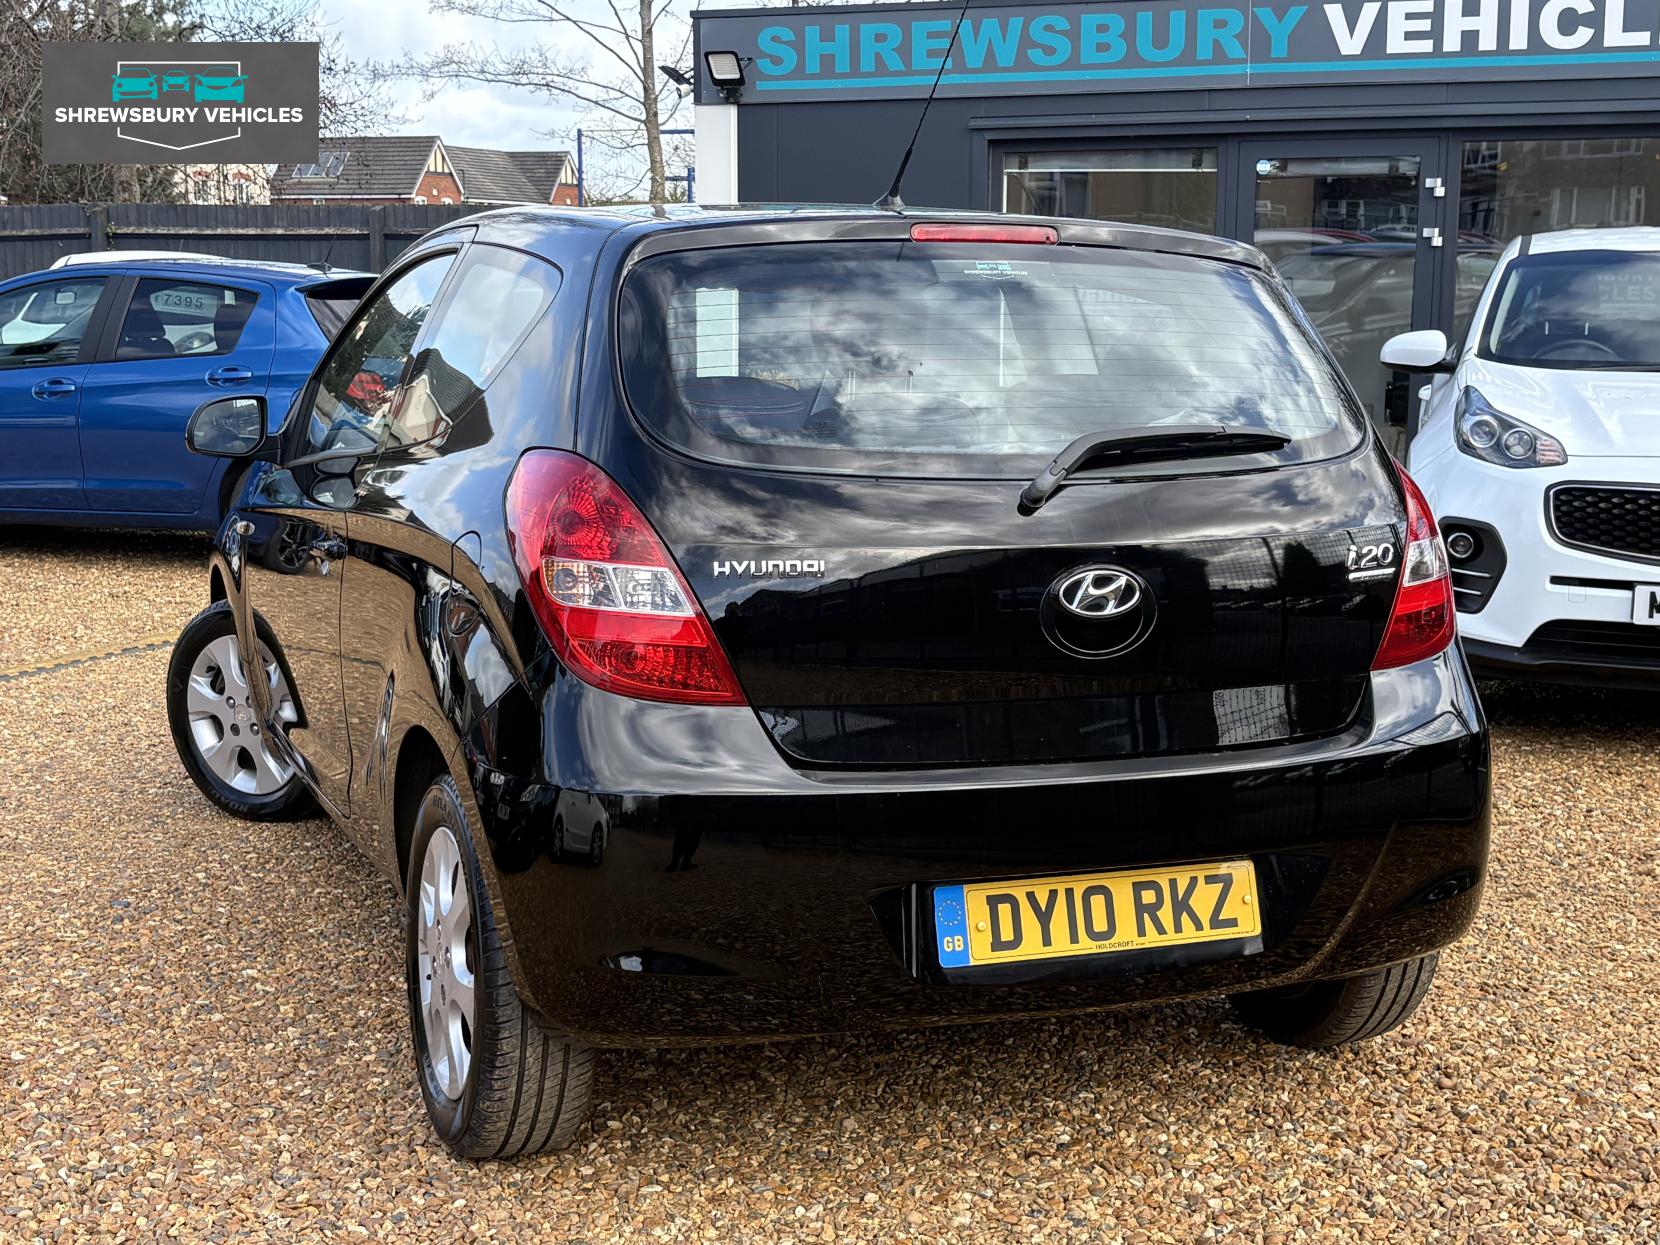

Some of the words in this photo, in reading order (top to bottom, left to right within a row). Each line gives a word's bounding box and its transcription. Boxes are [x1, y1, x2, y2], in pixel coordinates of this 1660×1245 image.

[756, 6, 1309, 76] SHREWSBURY
[1322, 0, 1660, 56] VEHICL
[713, 560, 825, 578] HYUNDAI
[986, 885, 1117, 952] DY10
[1132, 872, 1239, 938] RKZ
[943, 936, 964, 952] GB
[1095, 940, 1134, 950] HOLDCROFT
